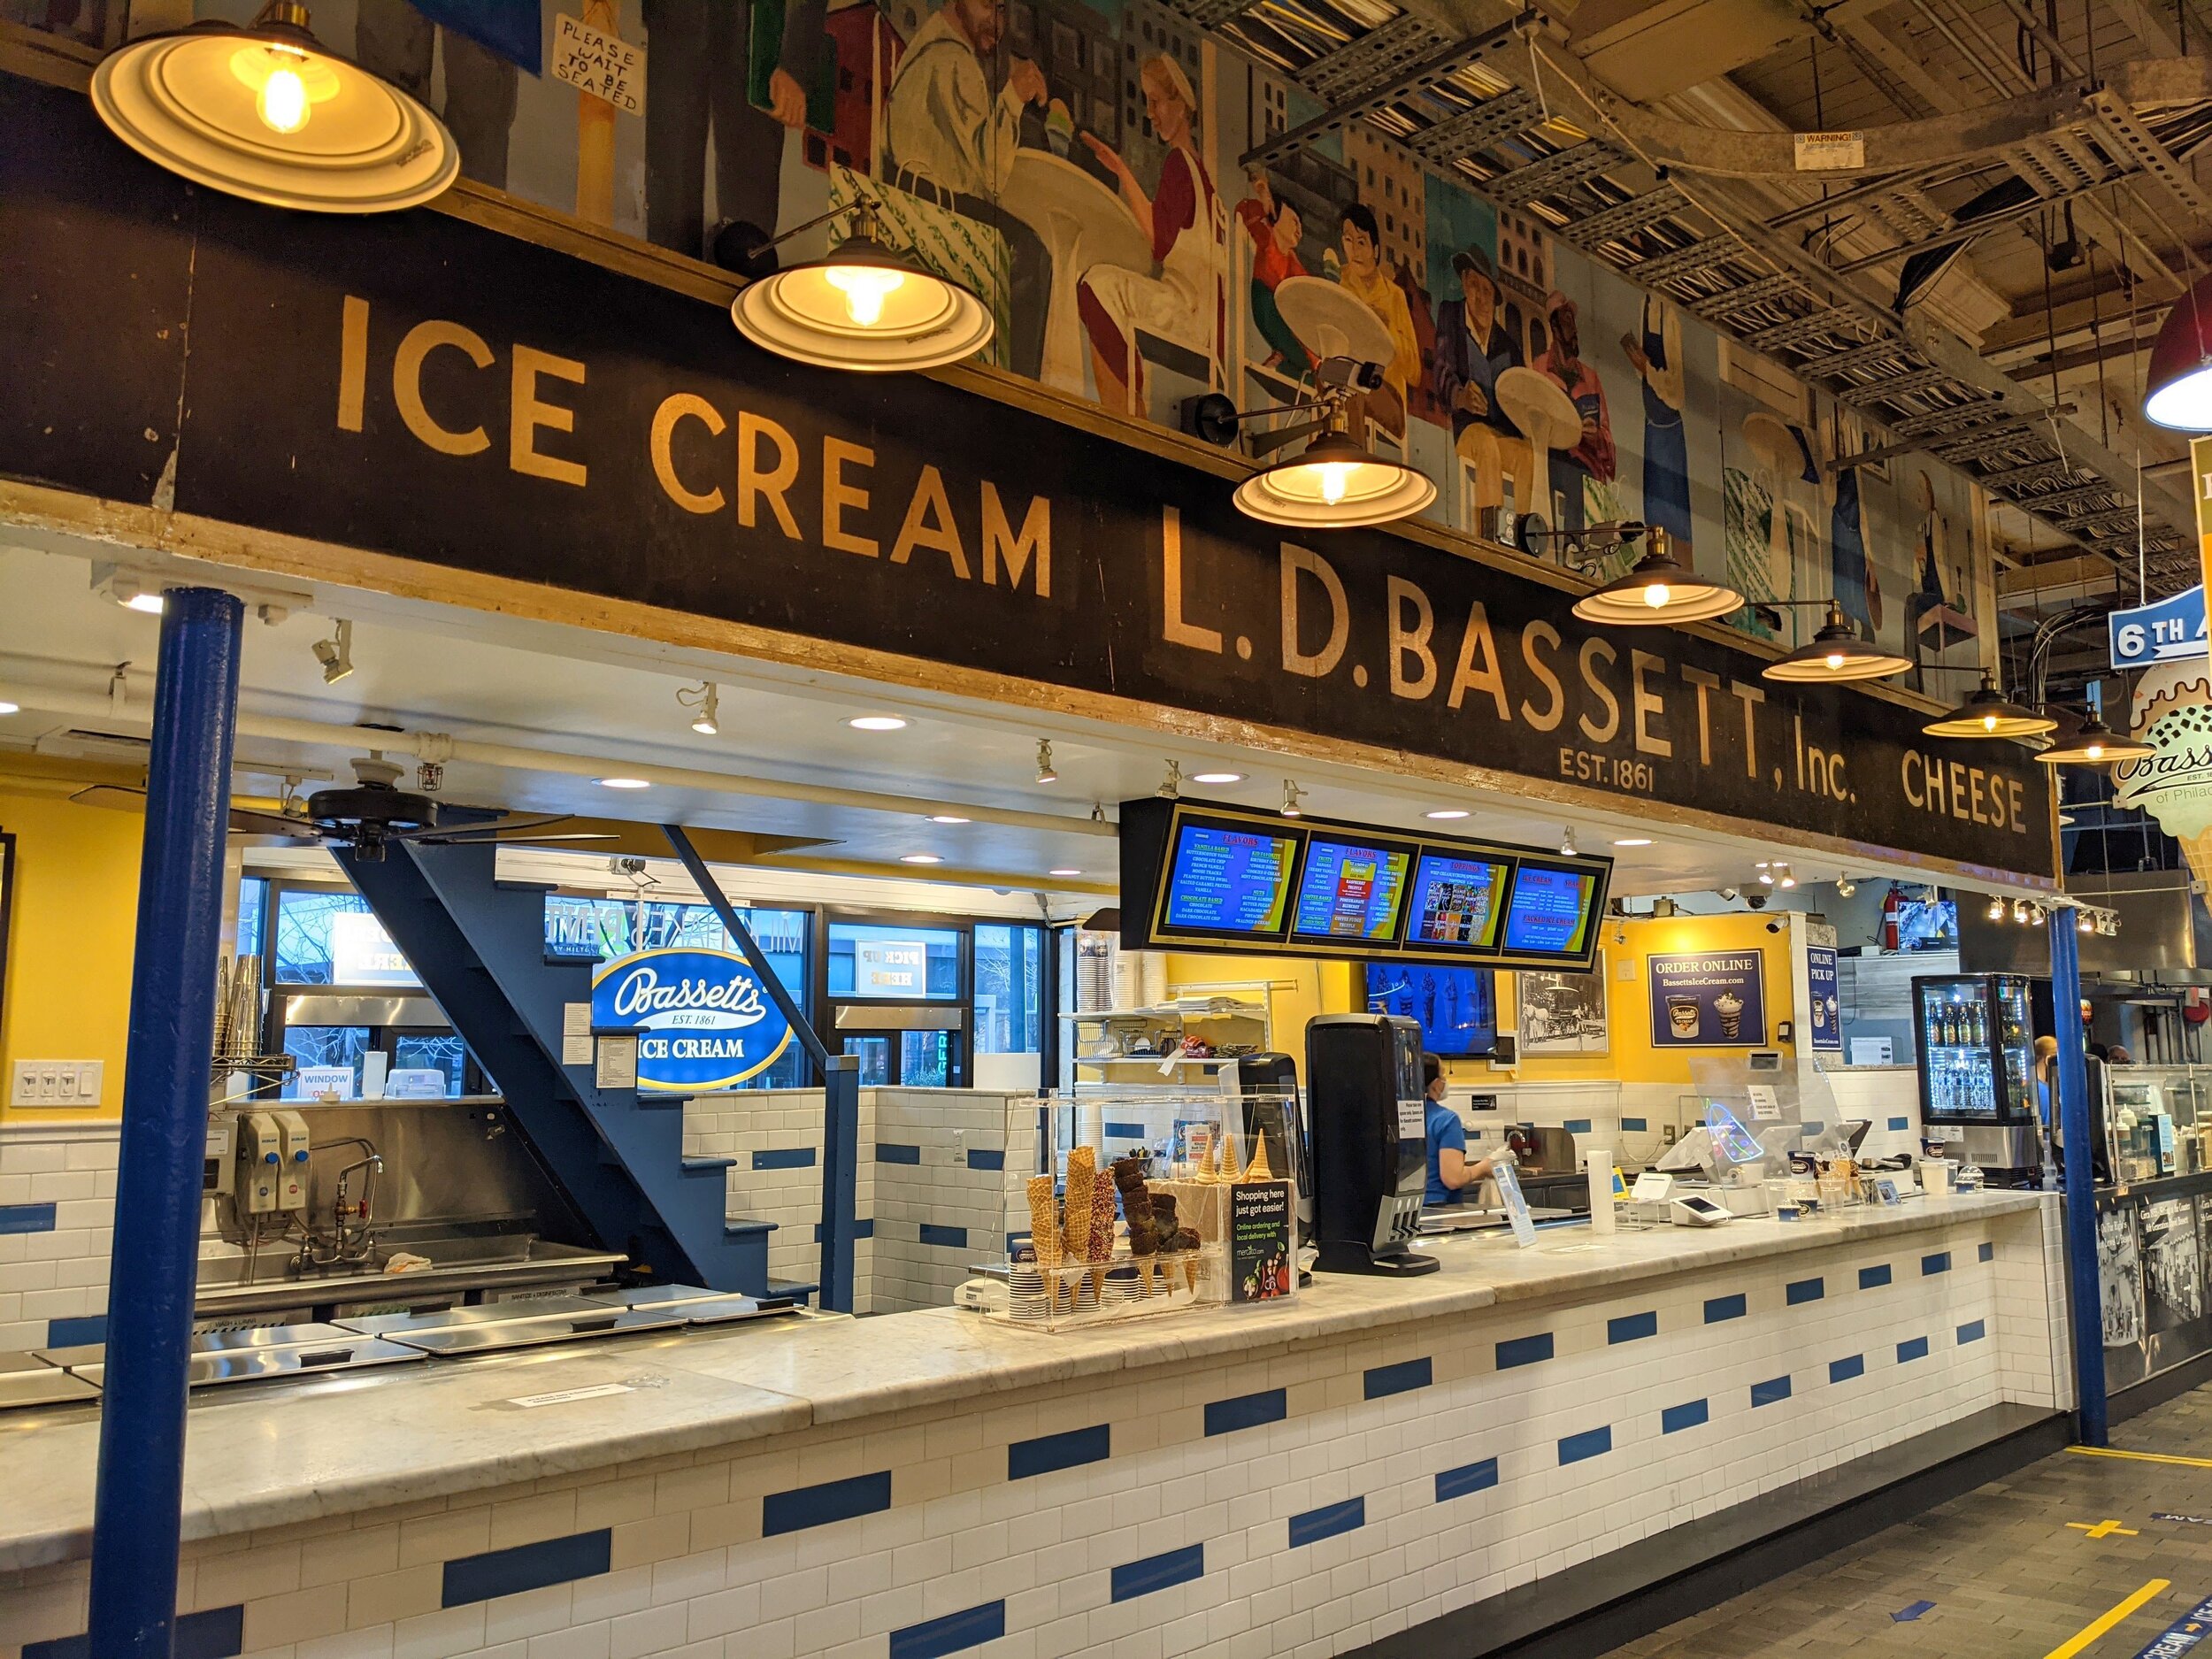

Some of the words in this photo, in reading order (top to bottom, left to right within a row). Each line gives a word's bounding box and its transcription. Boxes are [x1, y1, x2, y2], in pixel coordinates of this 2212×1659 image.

[563, 21, 634, 66] PLEASE
[578, 47, 627, 77] WAIT
[568, 53, 588, 73] TO
[604, 73, 627, 92] BE
[557, 64, 637, 110] SEATED
[1807, 134, 1851, 142] WARNING!
[337, 295, 588, 488] ICE
[650, 393, 1051, 599] CREAM
[1794, 714, 1857, 803] Inc.
[1901, 749, 2027, 835] CHEESE
[2117, 618, 2184, 657] 6TH
[1559, 748, 1609, 784] EST.
[1613, 758, 1654, 793] 1861
[2186, 772, 2205, 781] EST.
[2156, 794, 2169, 803] of
[1223, 833, 1258, 846] FLAVORS
[1345, 848, 1377, 858] FLAVORS
[1810, 952, 1833, 965] ONLINE
[1655, 961, 1701, 974] ORDER
[1701, 958, 1754, 972] ONLINE
[1663, 977, 1744, 987] BassettsIceCream.com
[1810, 969, 1825, 980] PICK
[1825, 970, 1834, 981] UP
[613, 967, 767, 1017] Bassetts
[672, 1015, 693, 1025] EST.
[695, 1015, 717, 1025] 1861
[672, 1039, 745, 1059] CREAM
[304, 1074, 349, 1084] WINDOW
[1236, 1189, 1269, 1202] Shopping
[1269, 1188, 1285, 1199] here
[1235, 1205, 1249, 1217] just
[1249, 1204, 1262, 1217] got
[1262, 1202, 1285, 1212] easier!
[1252, 1222, 1271, 1231] ordering
